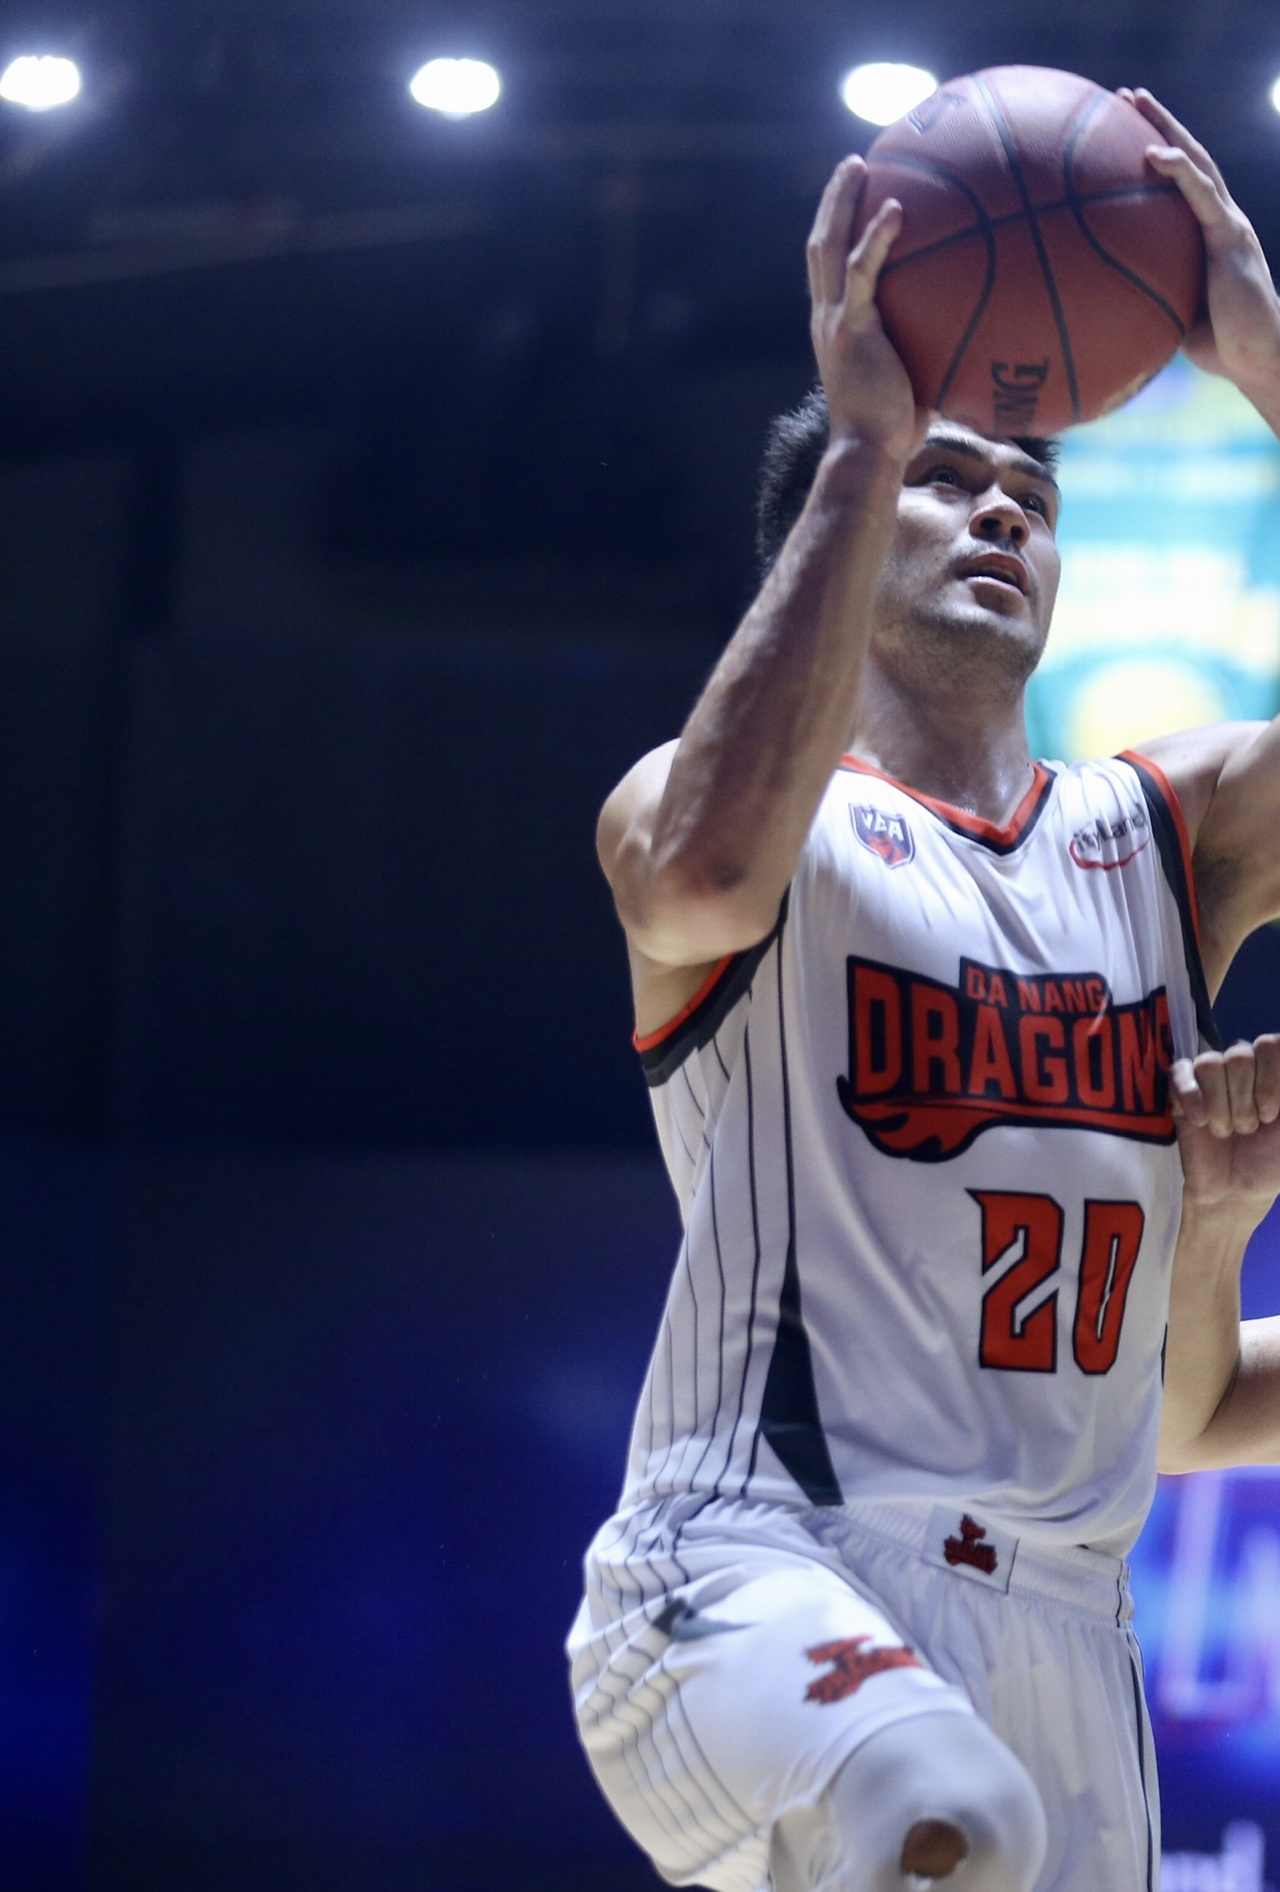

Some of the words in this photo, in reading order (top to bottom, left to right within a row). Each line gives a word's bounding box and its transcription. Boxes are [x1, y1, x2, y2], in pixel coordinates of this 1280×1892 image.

[966, 965, 1008, 1008] DA
[1017, 977, 1106, 1015] NANG
[965, 1187, 1145, 1375] 20
